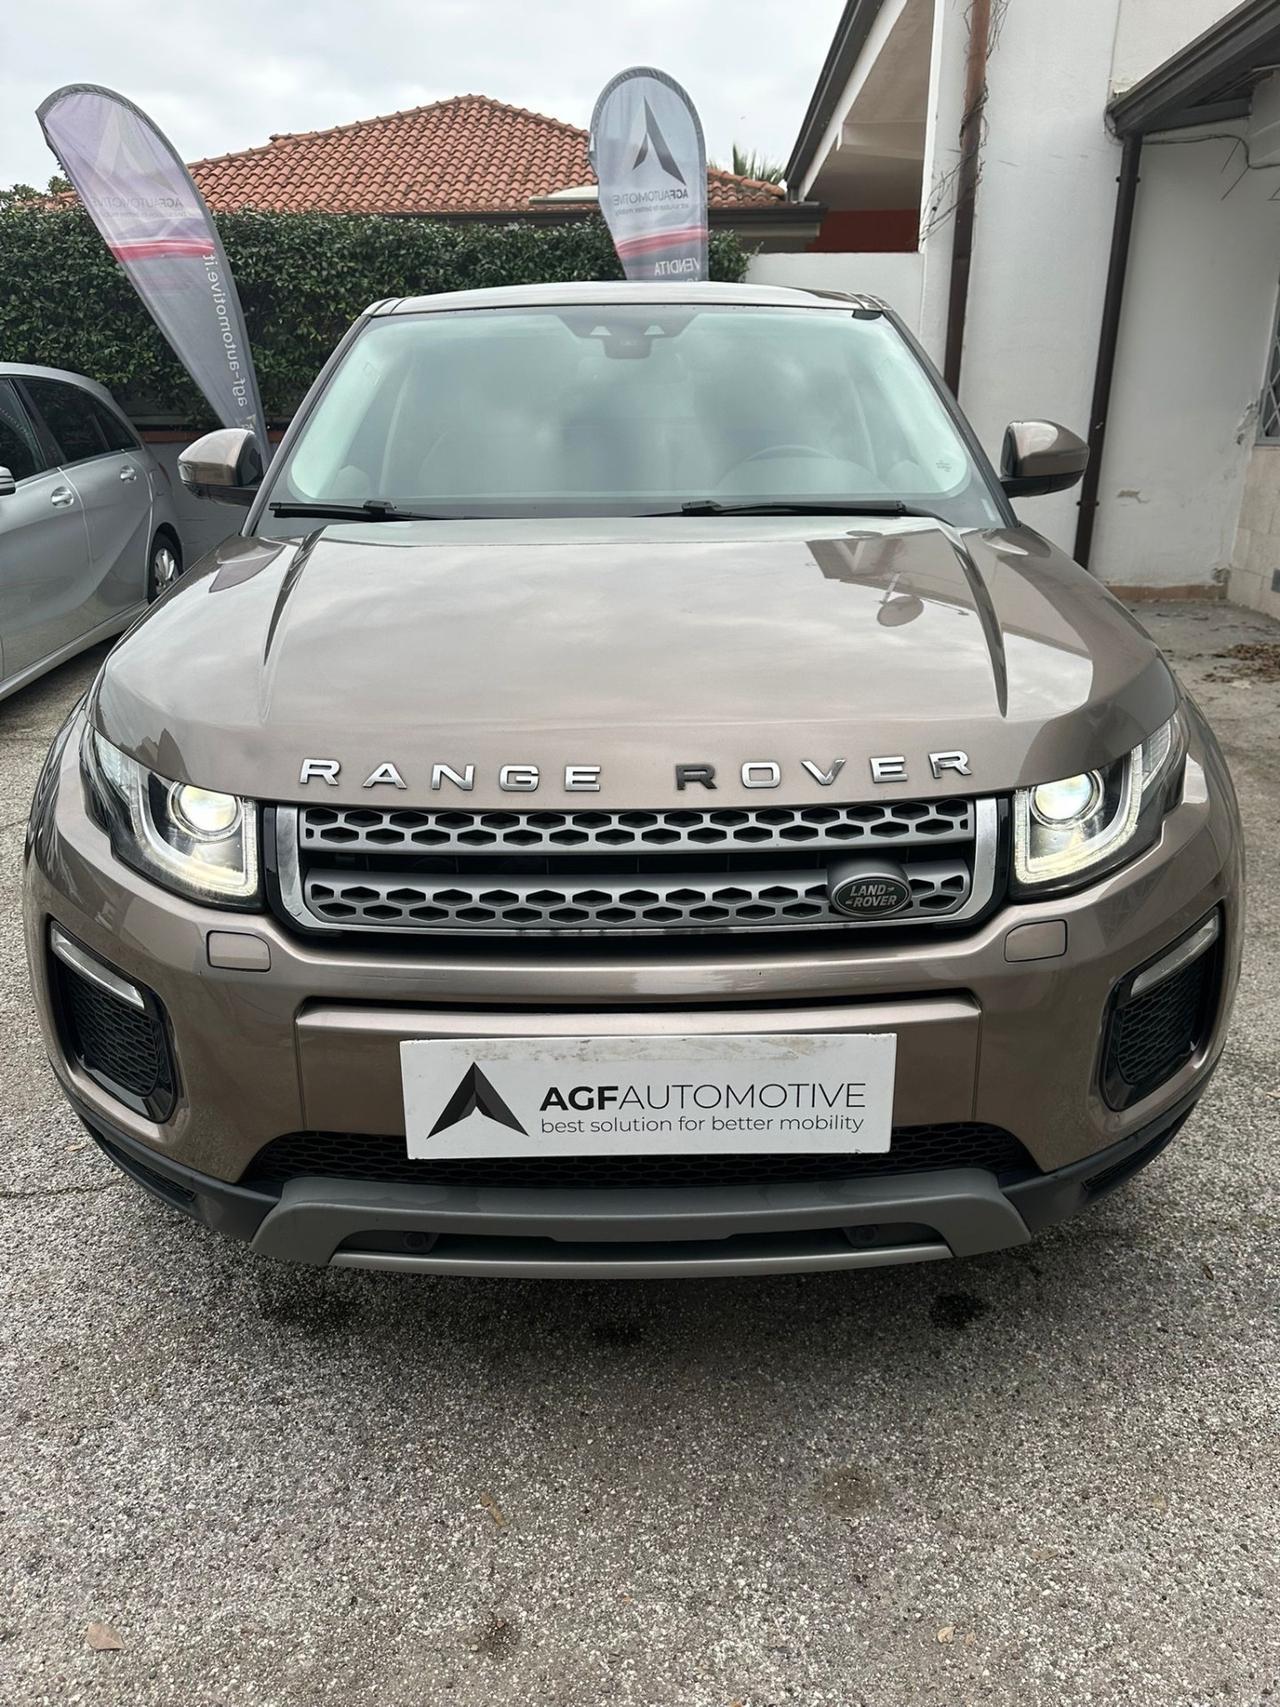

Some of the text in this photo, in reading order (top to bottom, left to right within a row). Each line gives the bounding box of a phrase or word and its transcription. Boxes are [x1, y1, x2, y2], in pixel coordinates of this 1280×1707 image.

[299, 750, 973, 793] RANGE ROVER
[849, 884, 887, 897] LAND
[852, 895, 898, 908] ROVER
[539, 1083, 867, 1112] AGFAUTOMOTIVE
[541, 1114, 864, 1134] best solution for better mobility
